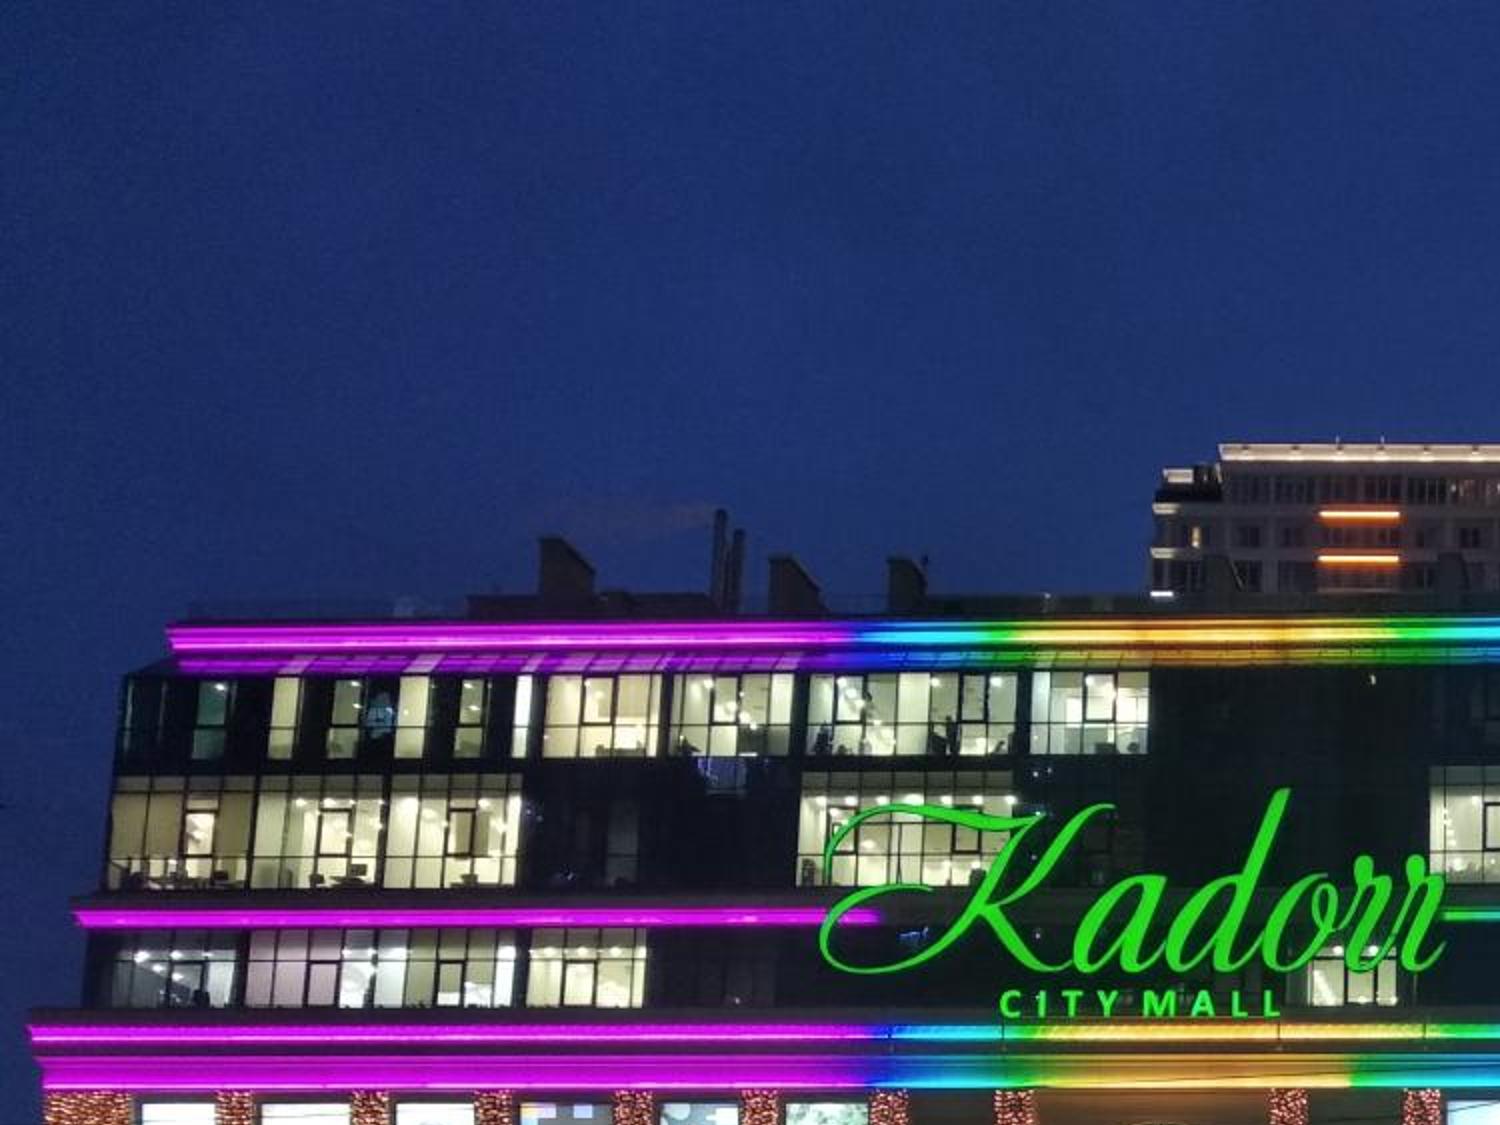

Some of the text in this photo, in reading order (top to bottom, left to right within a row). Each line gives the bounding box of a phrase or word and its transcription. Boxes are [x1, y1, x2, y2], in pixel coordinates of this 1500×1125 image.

[818, 787, 1448, 976] Kadorr
[999, 990, 1281, 1018] CITY MALL
